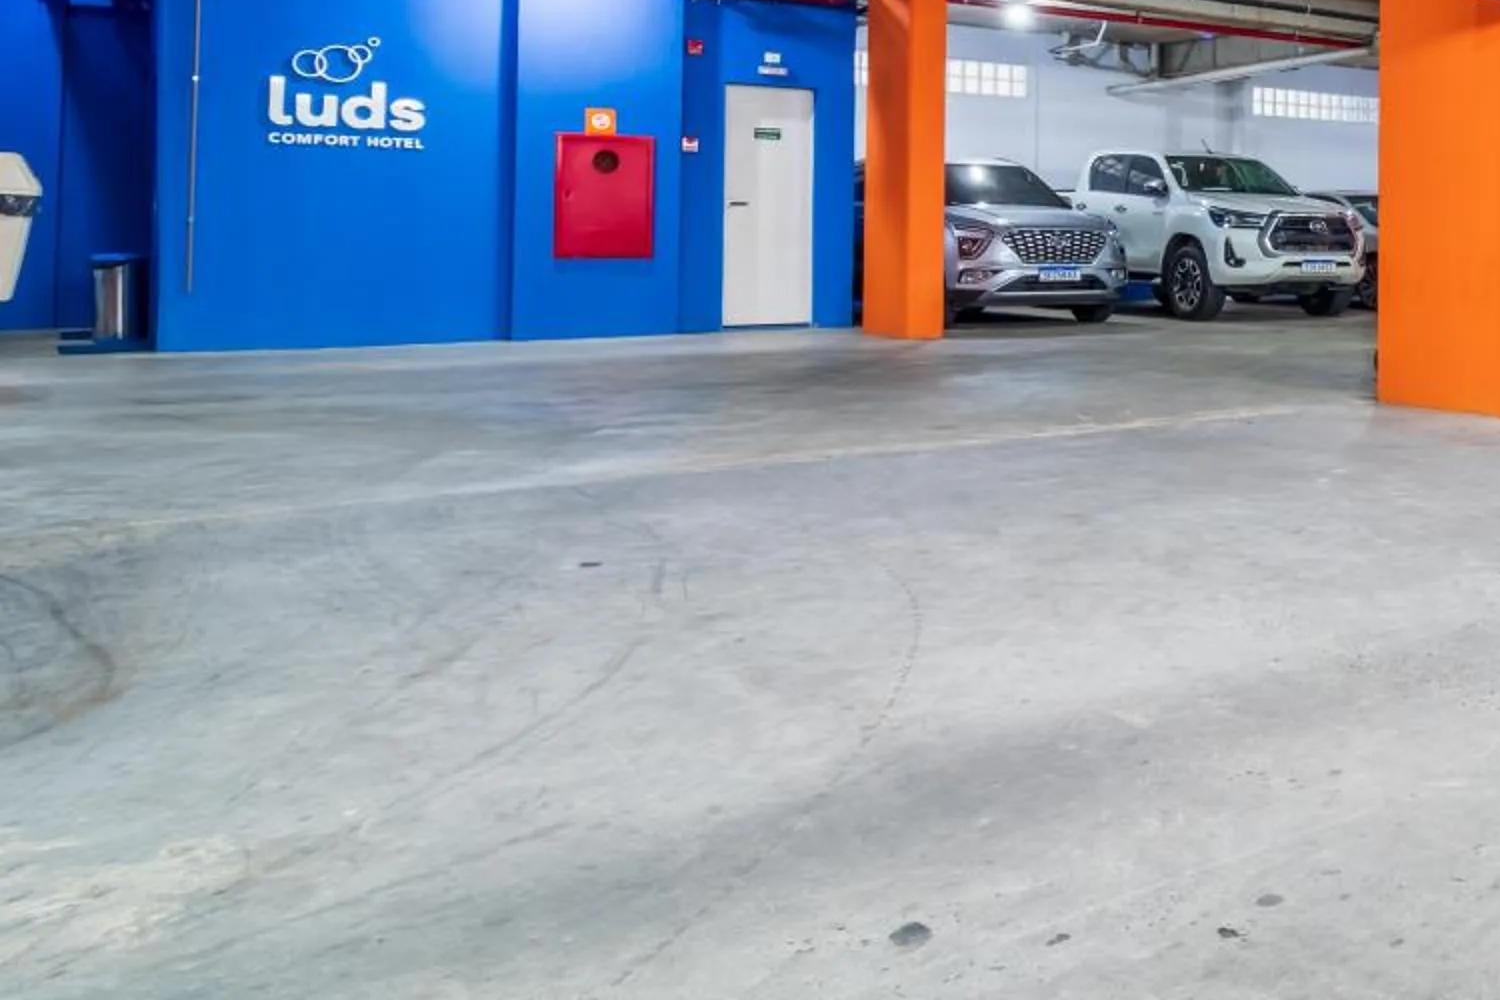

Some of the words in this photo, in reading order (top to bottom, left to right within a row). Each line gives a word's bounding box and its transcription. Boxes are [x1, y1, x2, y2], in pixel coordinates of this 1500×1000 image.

[269, 75, 426, 131] luds
[268, 132, 361, 147] COMFORT
[367, 136, 424, 149] HOTEL
